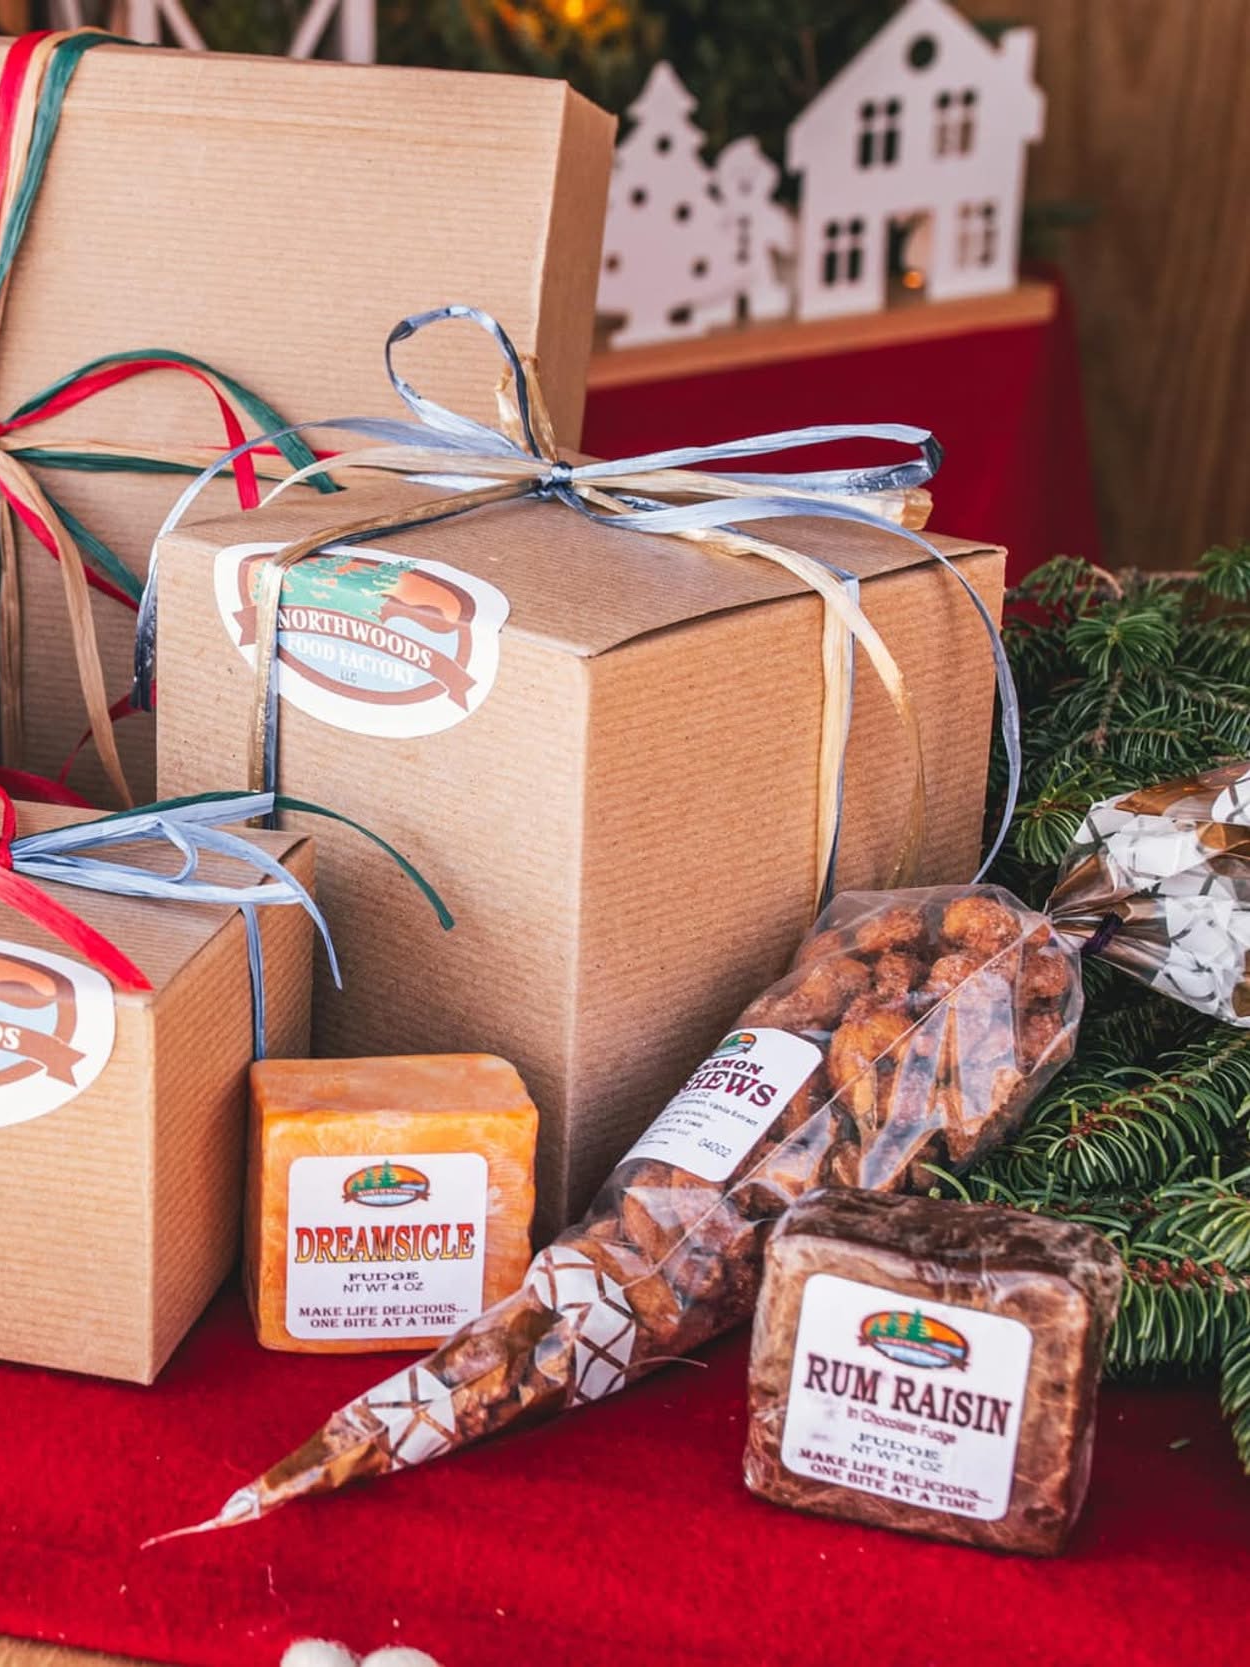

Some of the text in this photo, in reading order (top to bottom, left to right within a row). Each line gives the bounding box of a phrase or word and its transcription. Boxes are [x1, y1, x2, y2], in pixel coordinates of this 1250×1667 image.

[277, 609, 433, 670] NORTHWOODS
[287, 633, 417, 686] FOOD FACTORY
[340, 671, 358, 685] LLC
[295, 1222, 475, 1264] DREAMSICLE
[343, 1281, 425, 1293] NT WT 4 OZ
[349, 1271, 420, 1282] FUDGE
[299, 1306, 342, 1317] MAKE
[347, 1305, 378, 1316] LIFE
[310, 1315, 456, 1328] ONE BITE AT A TIME
[804, 1353, 1012, 1437] RUM RAISIN
[861, 1409, 917, 1434] Chocolate
[921, 1424, 957, 1445] Fudge
[850, 1443, 871, 1455] NT
[878, 1449, 900, 1463] WT
[920, 1461, 944, 1473] OZ
[859, 1432, 940, 1460] FUDGE
[798, 1448, 848, 1468] MAKE
[853, 1459, 888, 1478] LIFE
[810, 1463, 978, 1512] ONE BITE AT A TIME
